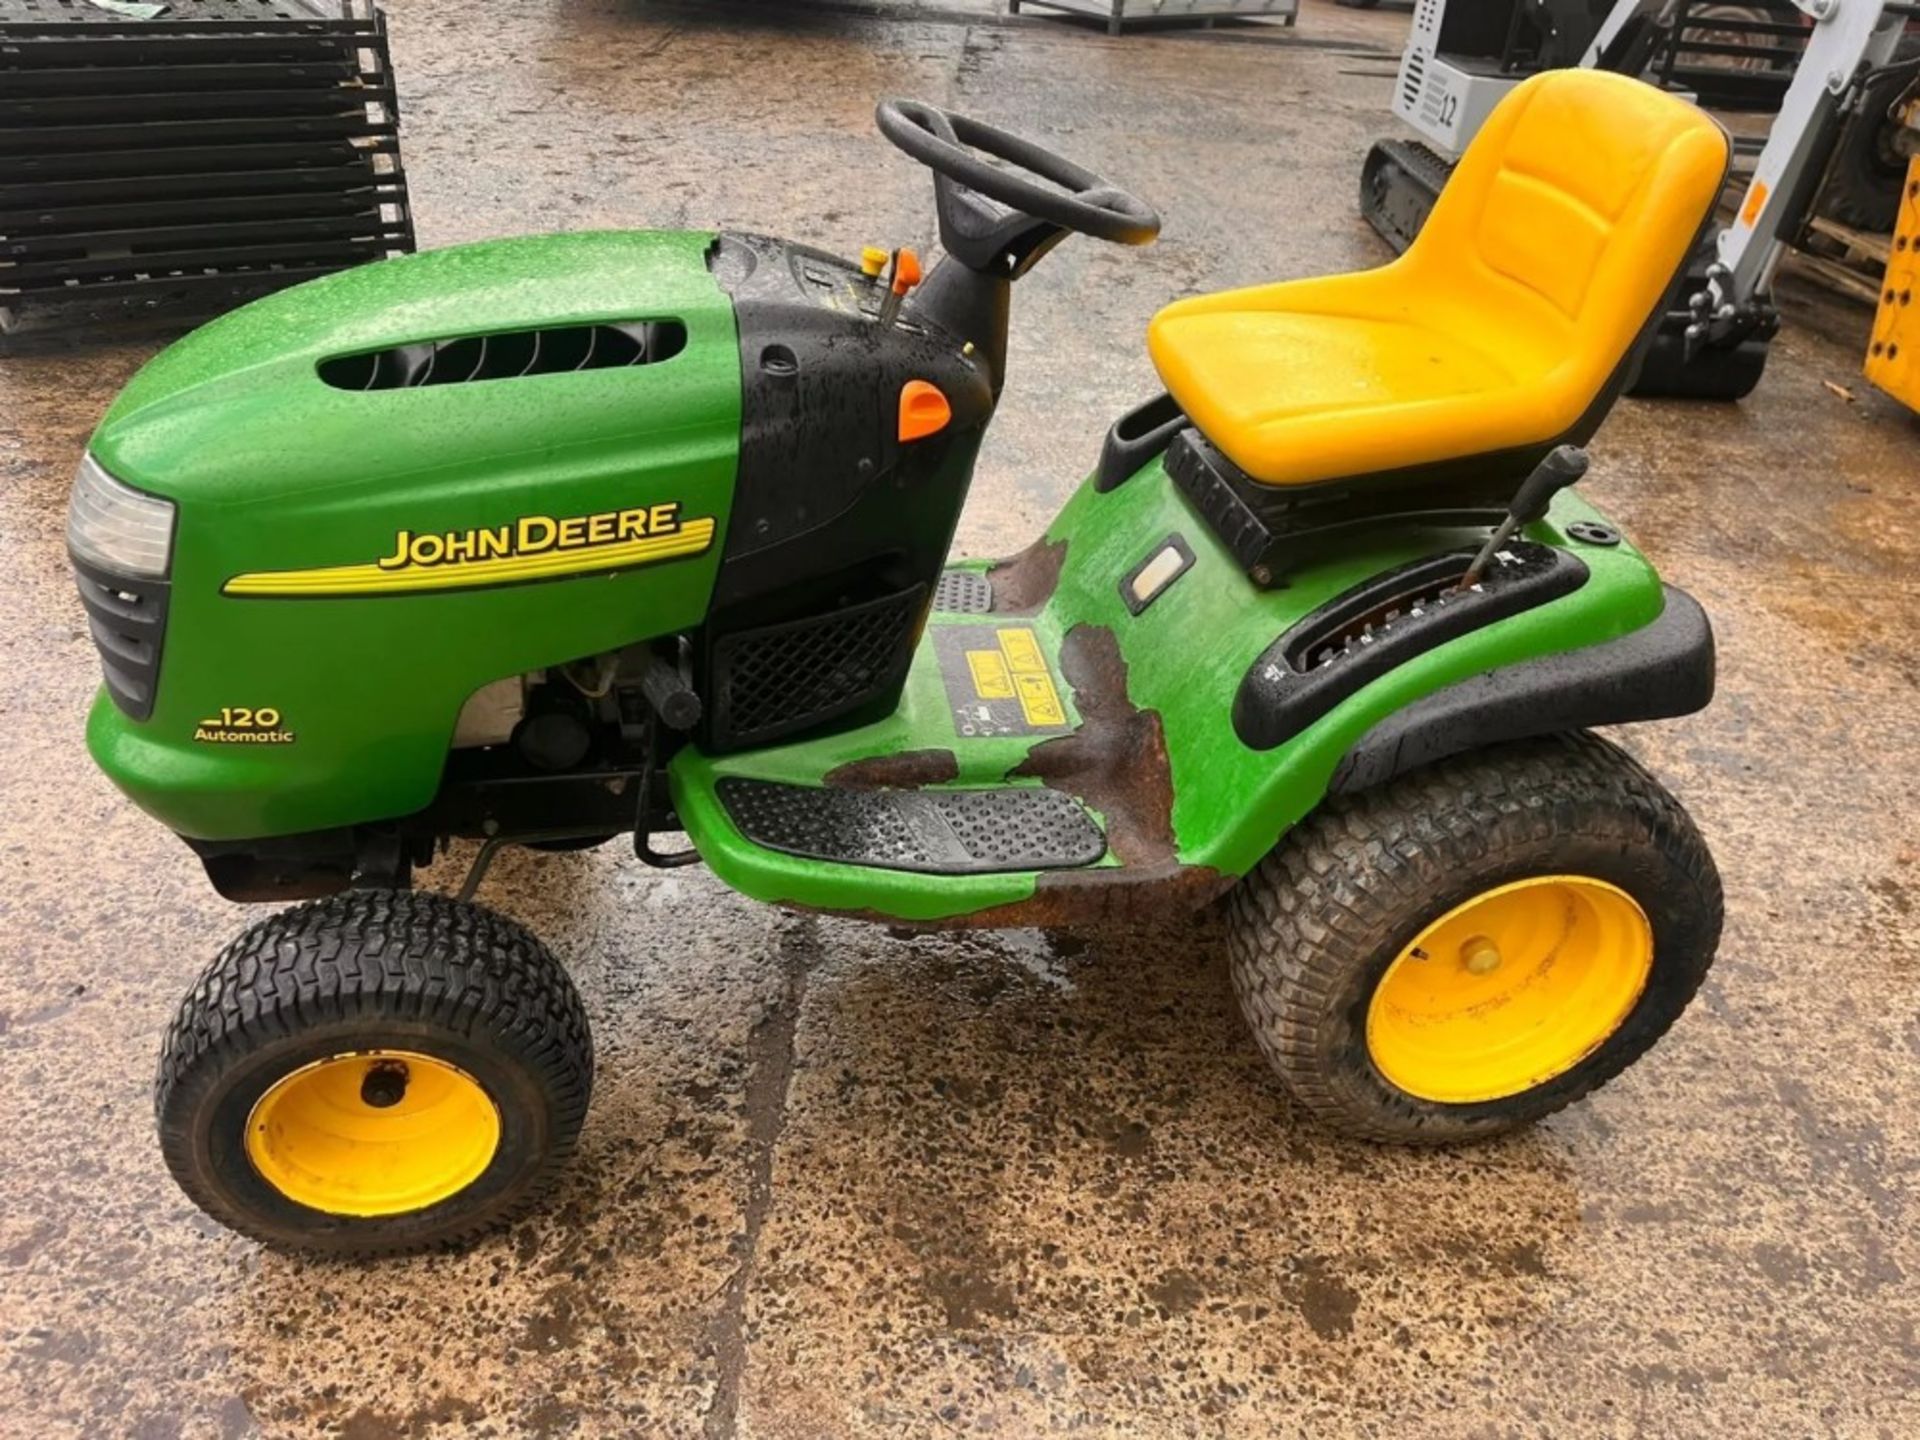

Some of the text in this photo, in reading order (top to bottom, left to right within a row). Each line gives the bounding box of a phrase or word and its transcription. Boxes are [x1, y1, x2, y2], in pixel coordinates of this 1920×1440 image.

[1440, 94, 1457, 127] 12
[379, 502, 680, 568] JOHN DEERE
[221, 707, 280, 727] 120
[194, 728, 294, 742] Automatic
